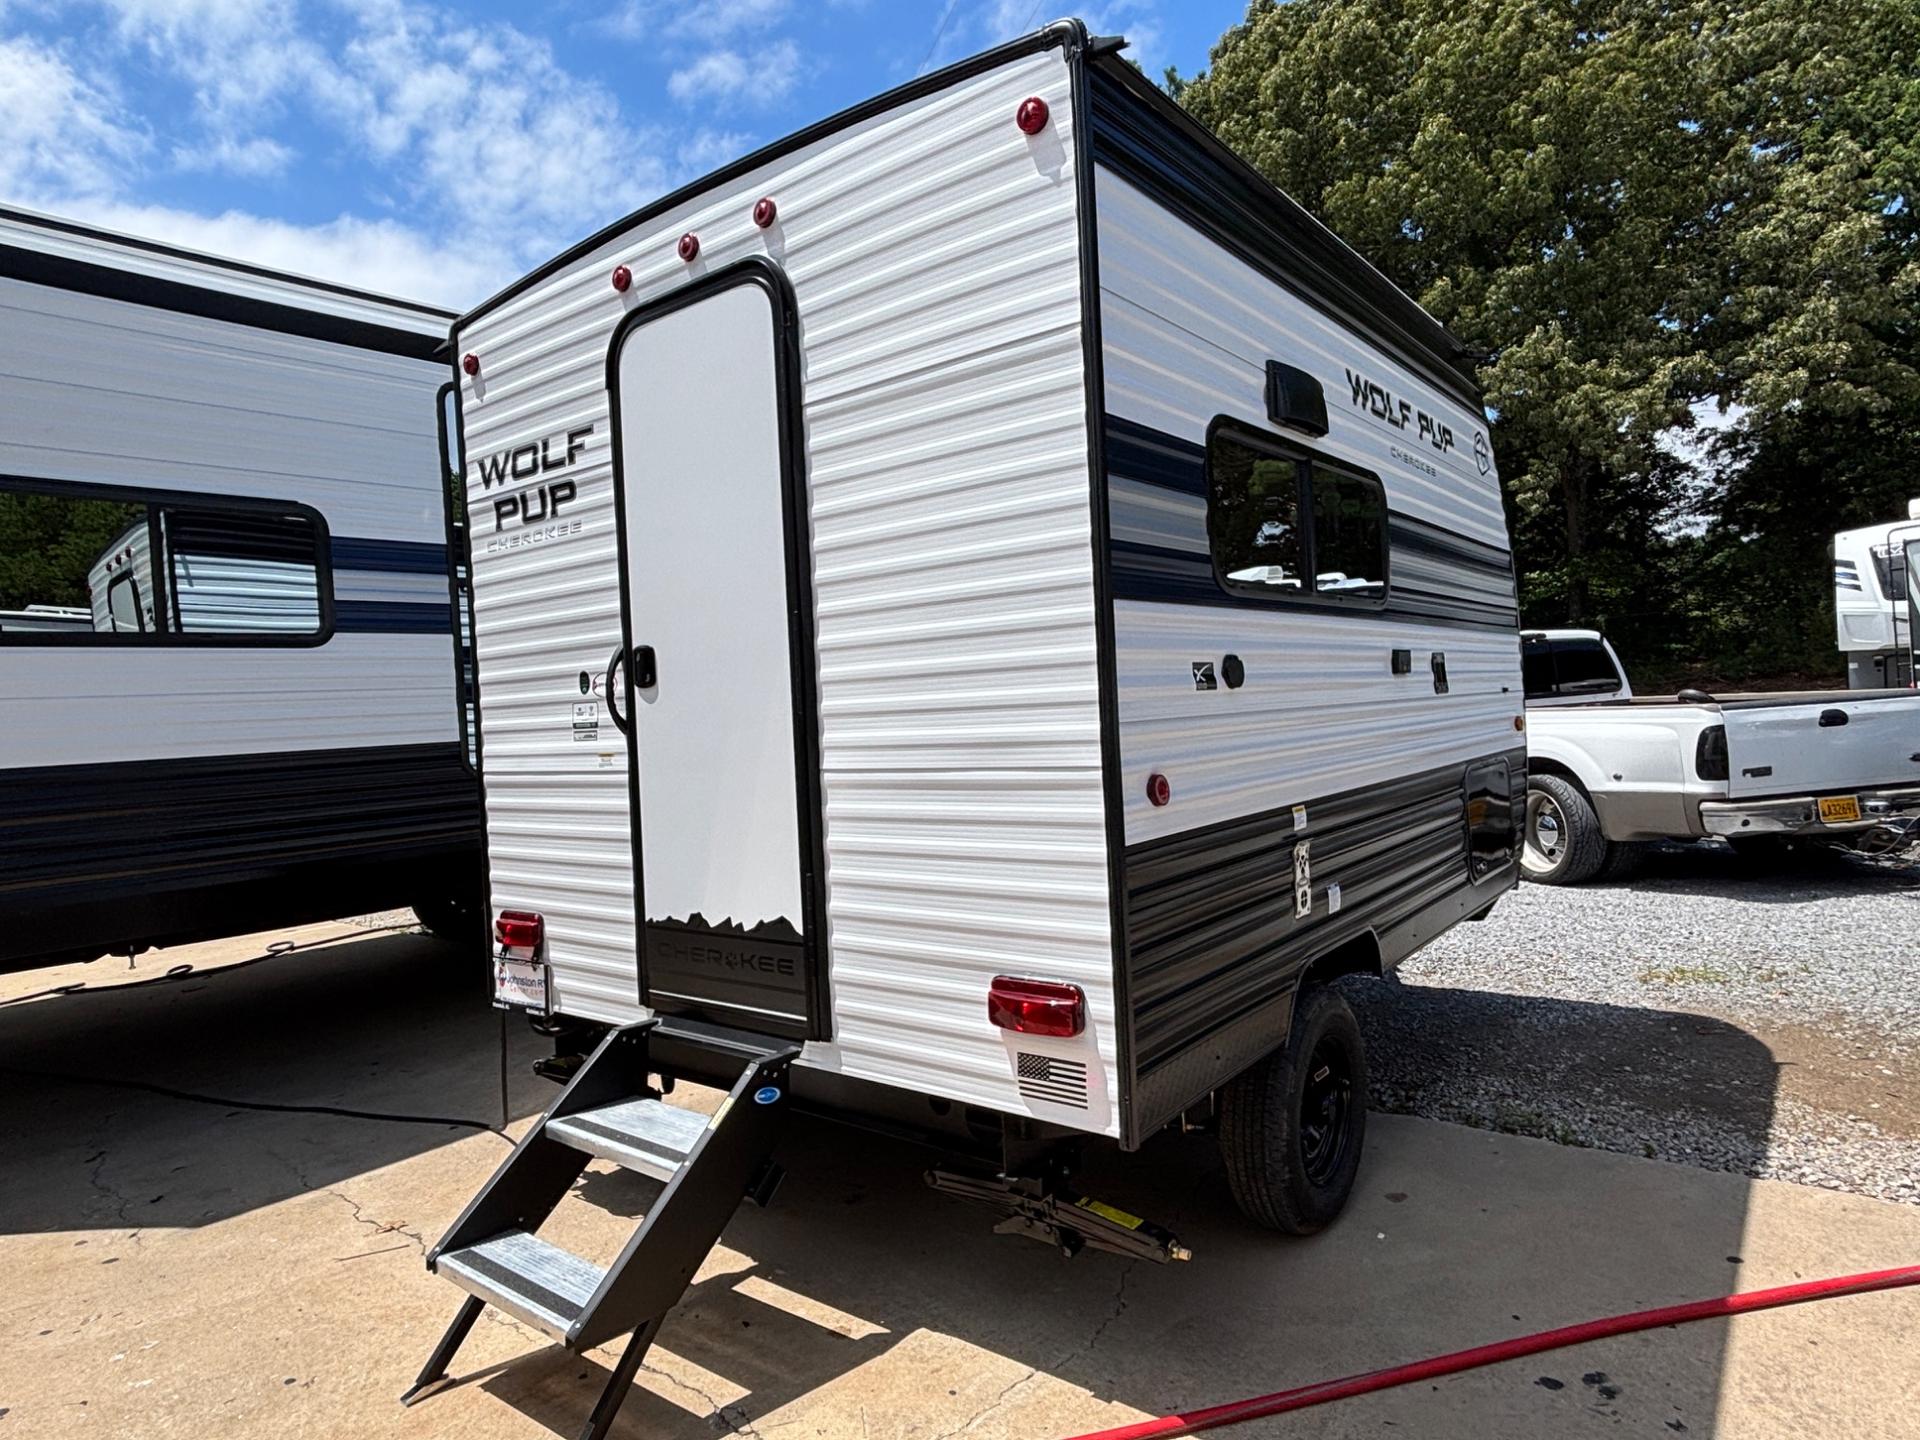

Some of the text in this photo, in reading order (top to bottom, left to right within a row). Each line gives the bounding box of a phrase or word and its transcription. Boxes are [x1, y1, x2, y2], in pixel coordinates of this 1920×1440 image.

[1345, 367, 1455, 453] WOLF PUP
[477, 423, 594, 490] WOLF
[1389, 446, 1437, 478] CHEROKEE
[493, 478, 577, 532] PUP
[486, 519, 582, 553] CHEROKEE
